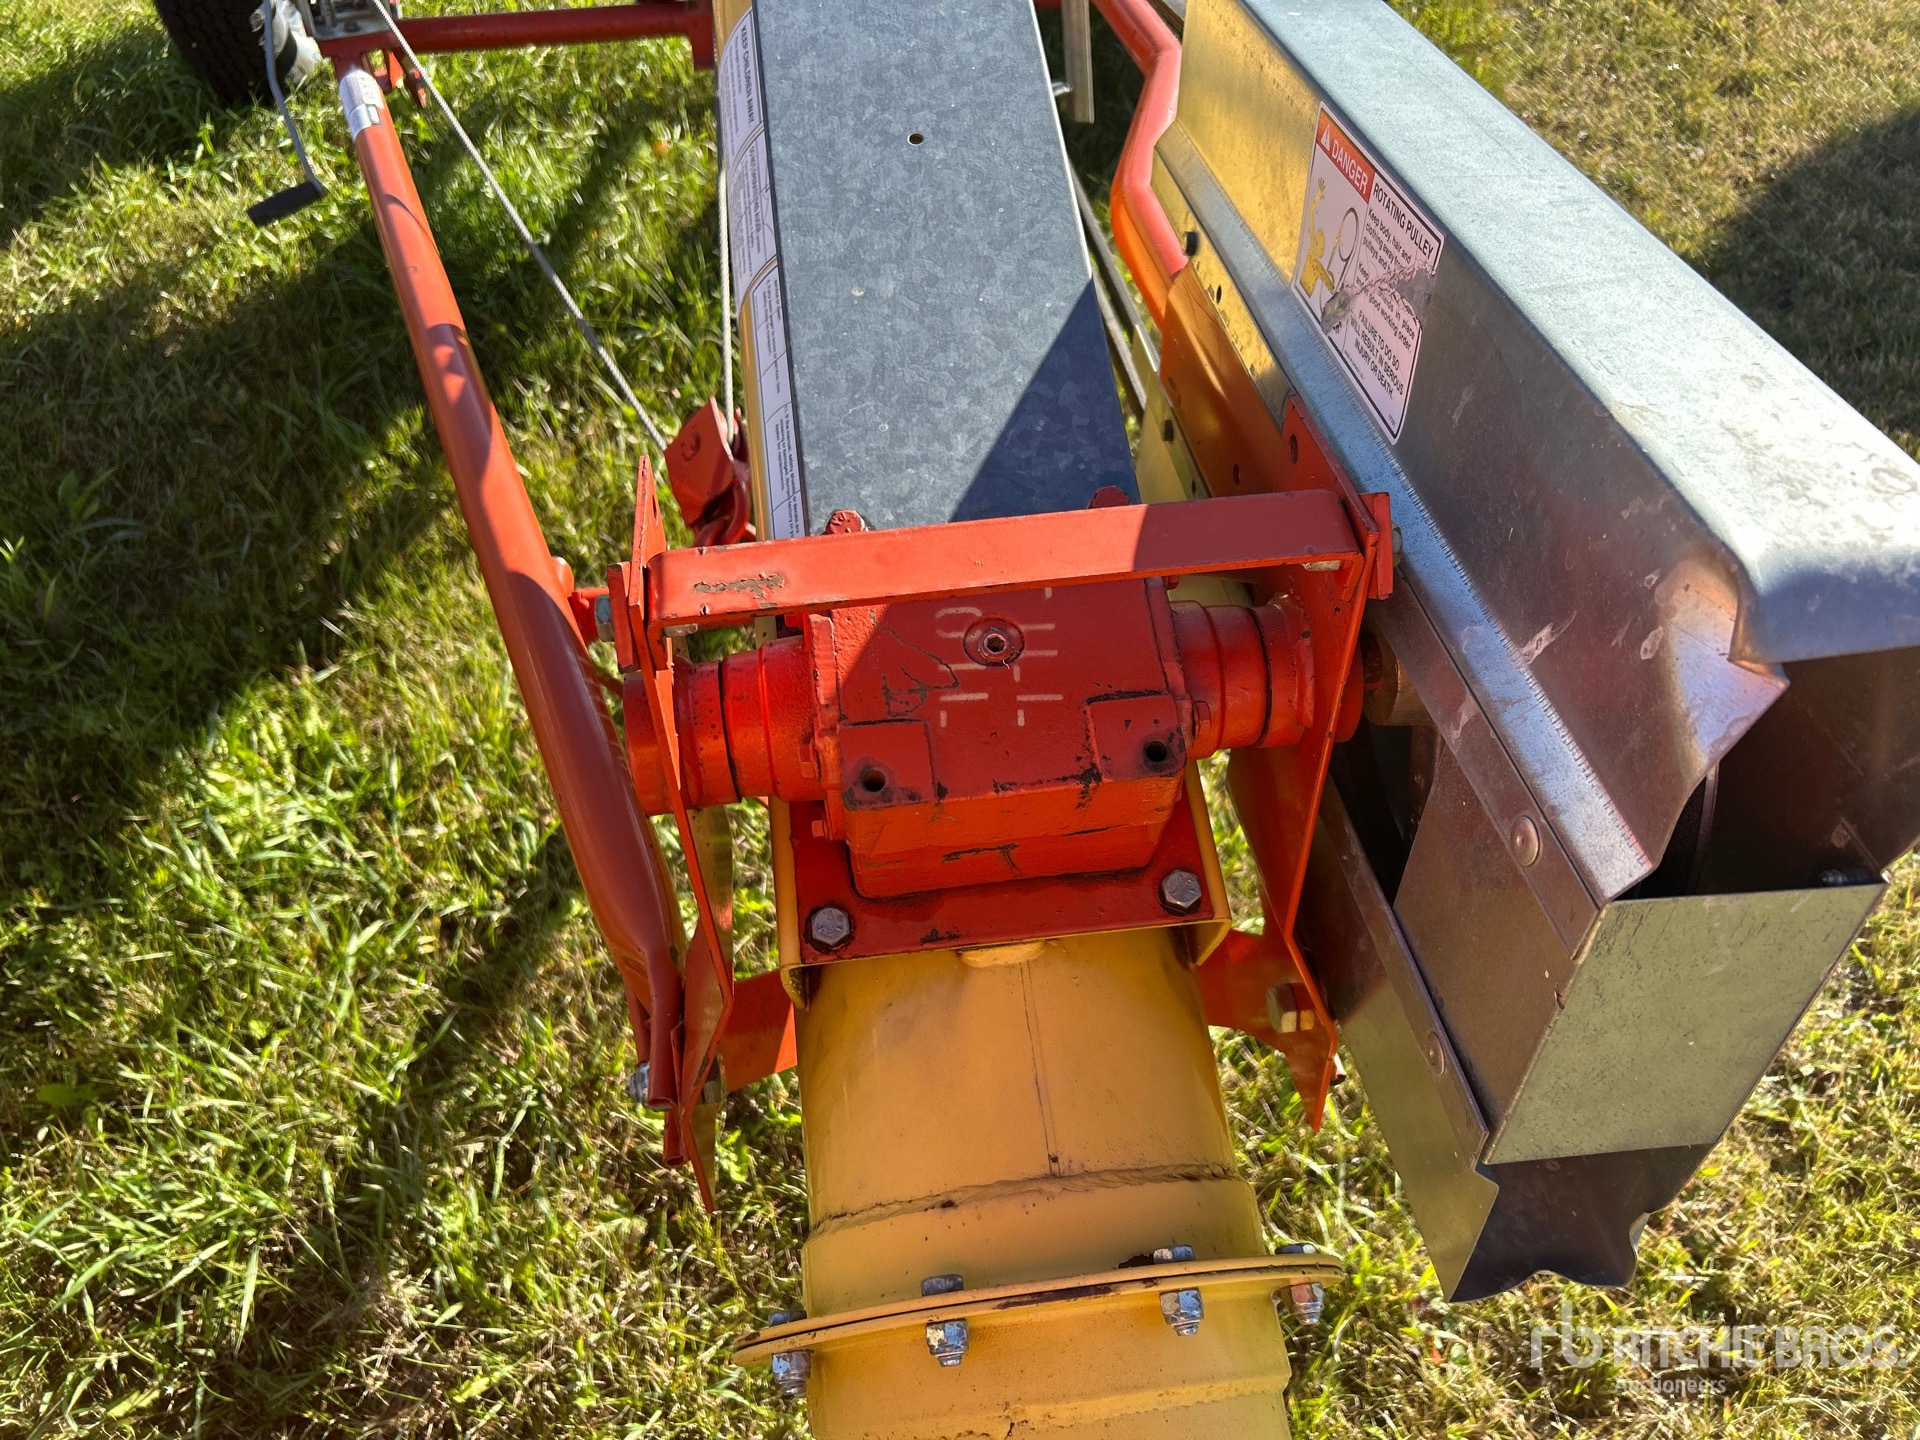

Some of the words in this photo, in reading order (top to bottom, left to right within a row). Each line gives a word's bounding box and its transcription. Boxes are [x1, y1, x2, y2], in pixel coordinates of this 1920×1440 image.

[743, 51, 752, 98] CHILDREN
[1331, 139, 1368, 194] DANGER
[1365, 223, 1384, 249] clothing
[1383, 242, 1394, 265] away
[1367, 207, 1379, 229] Keep
[1379, 219, 1392, 243] body,
[1392, 236, 1402, 251] hair
[1401, 248, 1411, 264] and
[1373, 182, 1406, 228] ROTATING
[1406, 222, 1434, 260] PULLEY
[1378, 253, 1388, 269] and
[1358, 310, 1377, 340] FAILURE
[1377, 336, 1384, 349] TO
[1384, 345, 1392, 360] DO
[1392, 355, 1399, 370] SO
[1368, 294, 1380, 312] good
[1380, 307, 1398, 337] working
[1398, 331, 1411, 352] order.
[1402, 319, 1415, 339] place
[1351, 317, 1361, 337] WILL
[1360, 331, 1378, 359] RESULT
[1378, 354, 1383, 367] IN
[1383, 363, 1403, 395] SERIOUS
[1354, 339, 1371, 365] INJURY
[1371, 361, 1377, 376] OR
[1377, 370, 1393, 400] DEATH.
